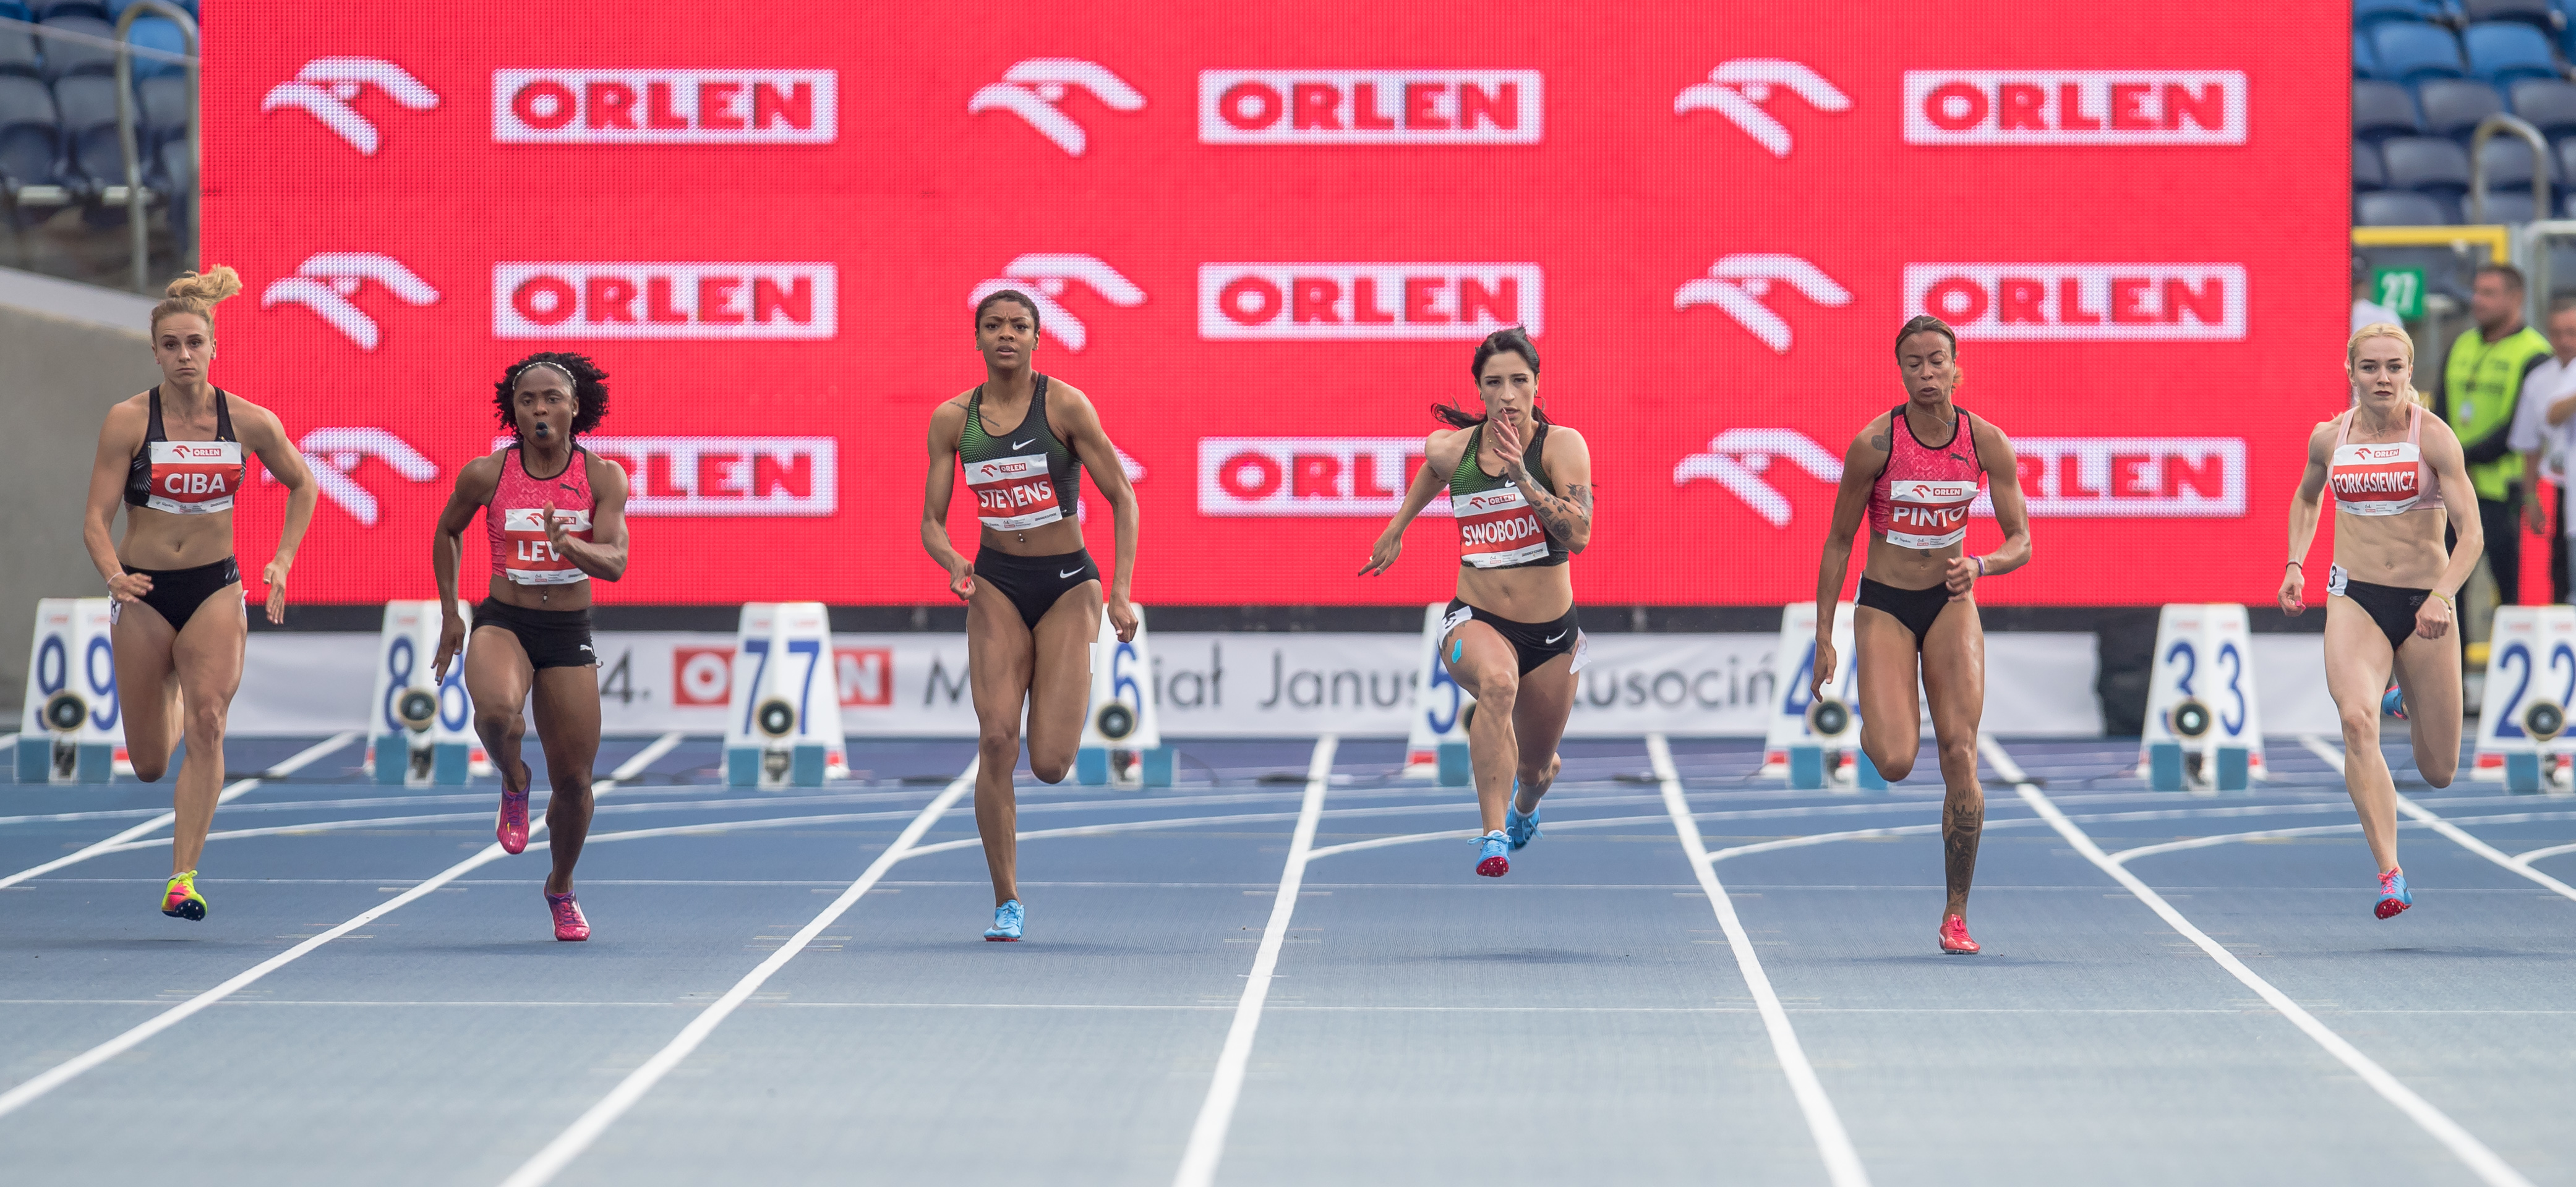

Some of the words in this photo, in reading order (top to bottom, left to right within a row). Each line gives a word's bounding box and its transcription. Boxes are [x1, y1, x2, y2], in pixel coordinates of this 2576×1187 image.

[511, 80, 812, 130] ORLEN
[1220, 80, 1519, 130] ORLEN
[1924, 80, 2225, 130] ORLEN
[511, 276, 812, 325] ORLEN
[1220, 276, 1519, 325] ORLEN
[1924, 276, 2225, 325] ORLEN
[1001, 464, 1026, 472] ORLEN
[2375, 449, 2399, 457] ORLEN
[164, 473, 226, 494] CIBA
[600, 453, 812, 498] LEN
[977, 480, 1051, 508] STEVENS
[1219, 453, 1450, 500] ORL
[2016, 453, 2224, 498] RLEN
[1489, 495, 1515, 504] ORLEN
[1893, 505, 1967, 527] PINTO
[1462, 514, 1541, 547] SWOBODA
[517, 540, 560, 562] LEV
[2329, 566, 2337, 588] 3
